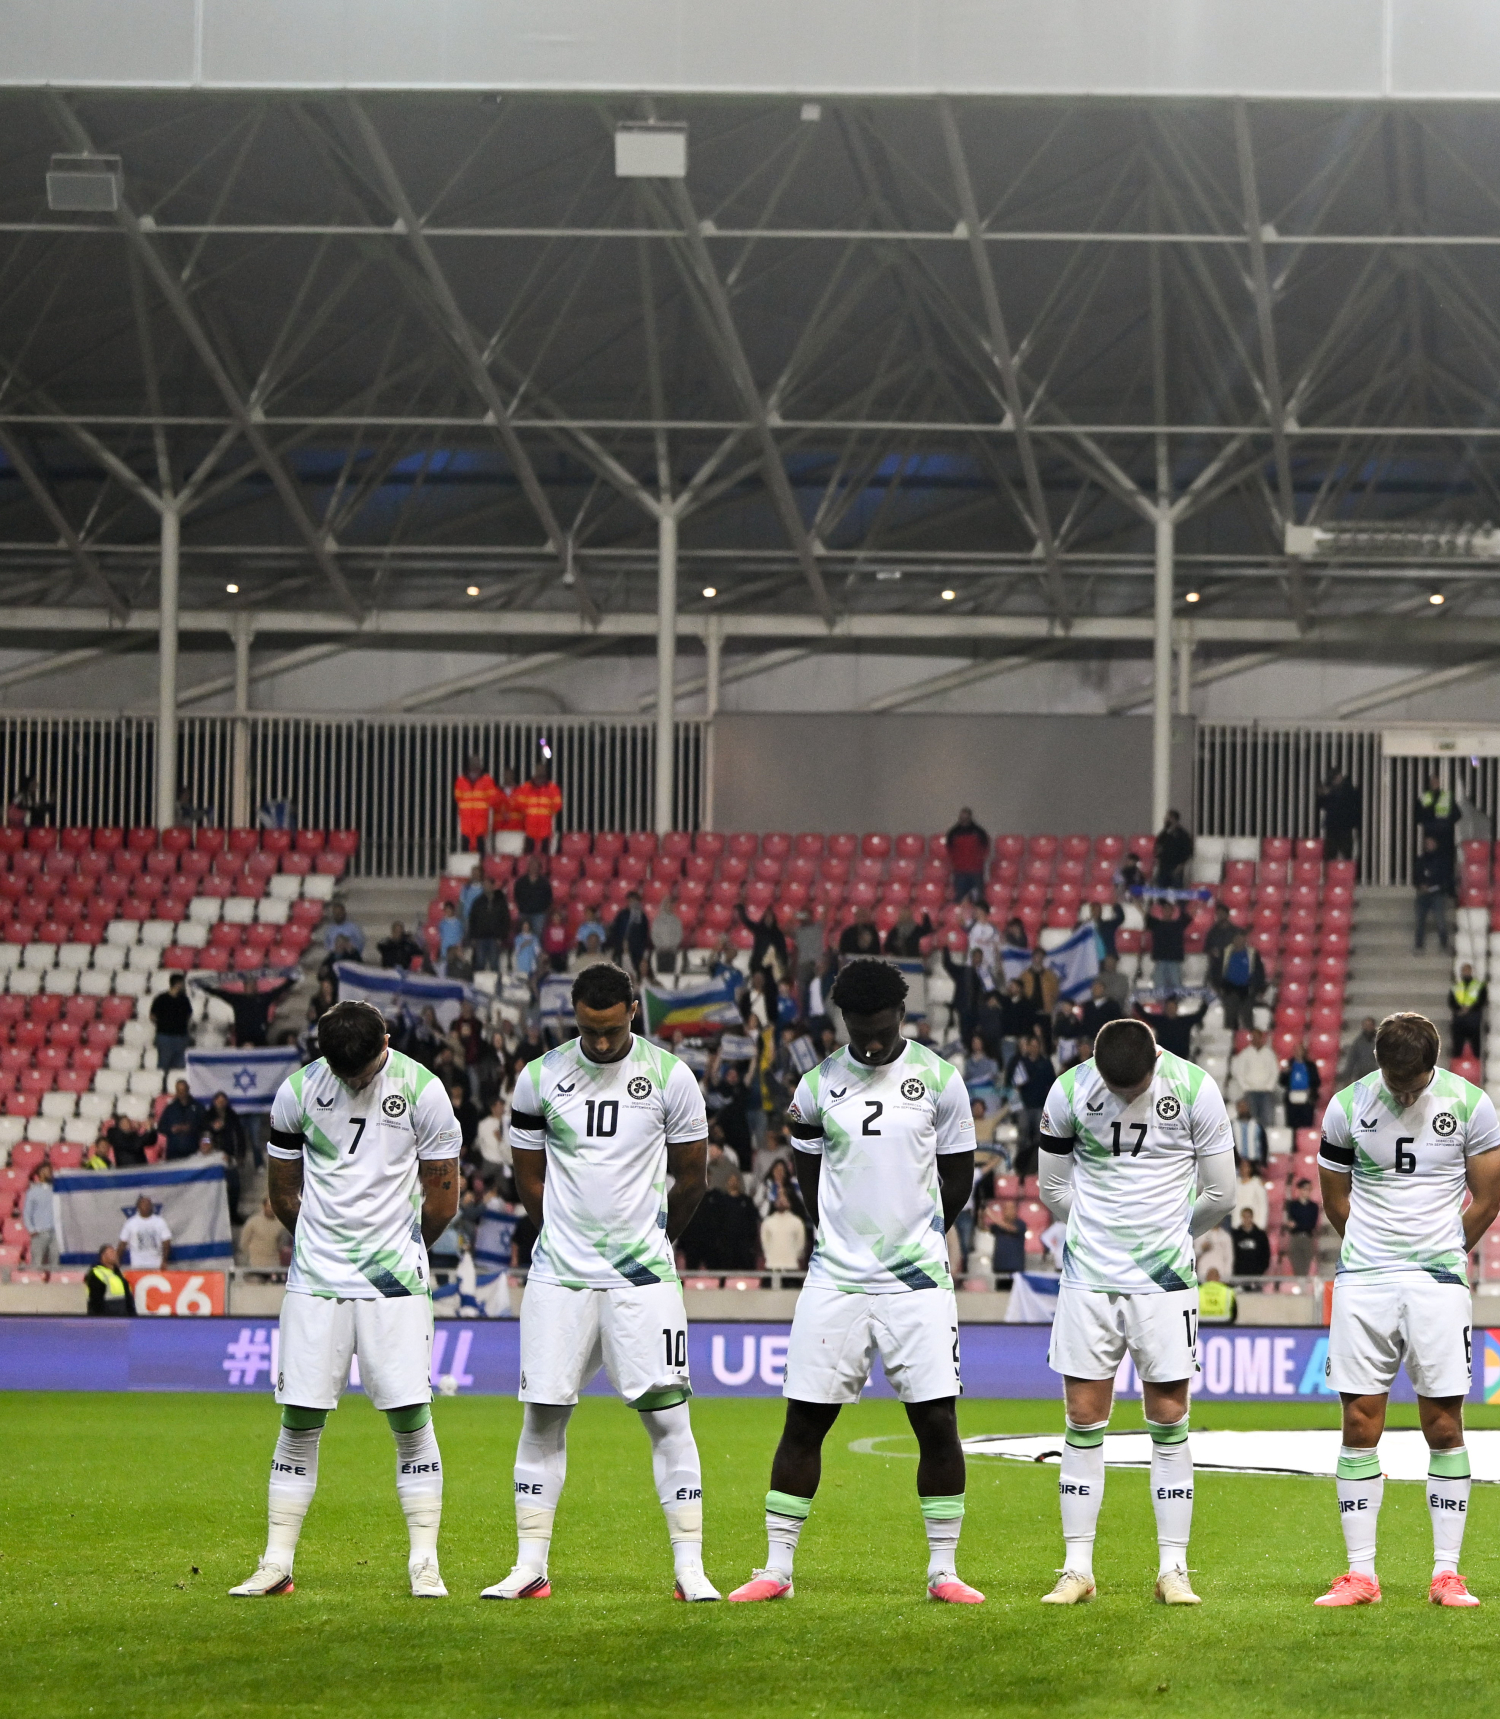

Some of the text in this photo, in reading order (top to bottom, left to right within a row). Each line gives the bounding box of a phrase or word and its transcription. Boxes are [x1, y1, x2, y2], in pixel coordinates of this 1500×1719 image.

[348, 1117, 367, 1155] 7
[584, 1099, 620, 1138] 10
[862, 1100, 884, 1136] 2
[1110, 1121, 1149, 1158] 17
[1395, 1136, 1417, 1174] 6
[134, 1274, 212, 1316] C6
[663, 1328, 686, 1367] 10
[401, 1462, 440, 1475] ÉIRE
[514, 1479, 544, 1495] IRE
[676, 1487, 703, 1501] ÉIR
[1157, 1487, 1194, 1500] ÉIRE
[1430, 1493, 1468, 1512] ÉIRE
[1338, 1498, 1368, 1513] IRE
